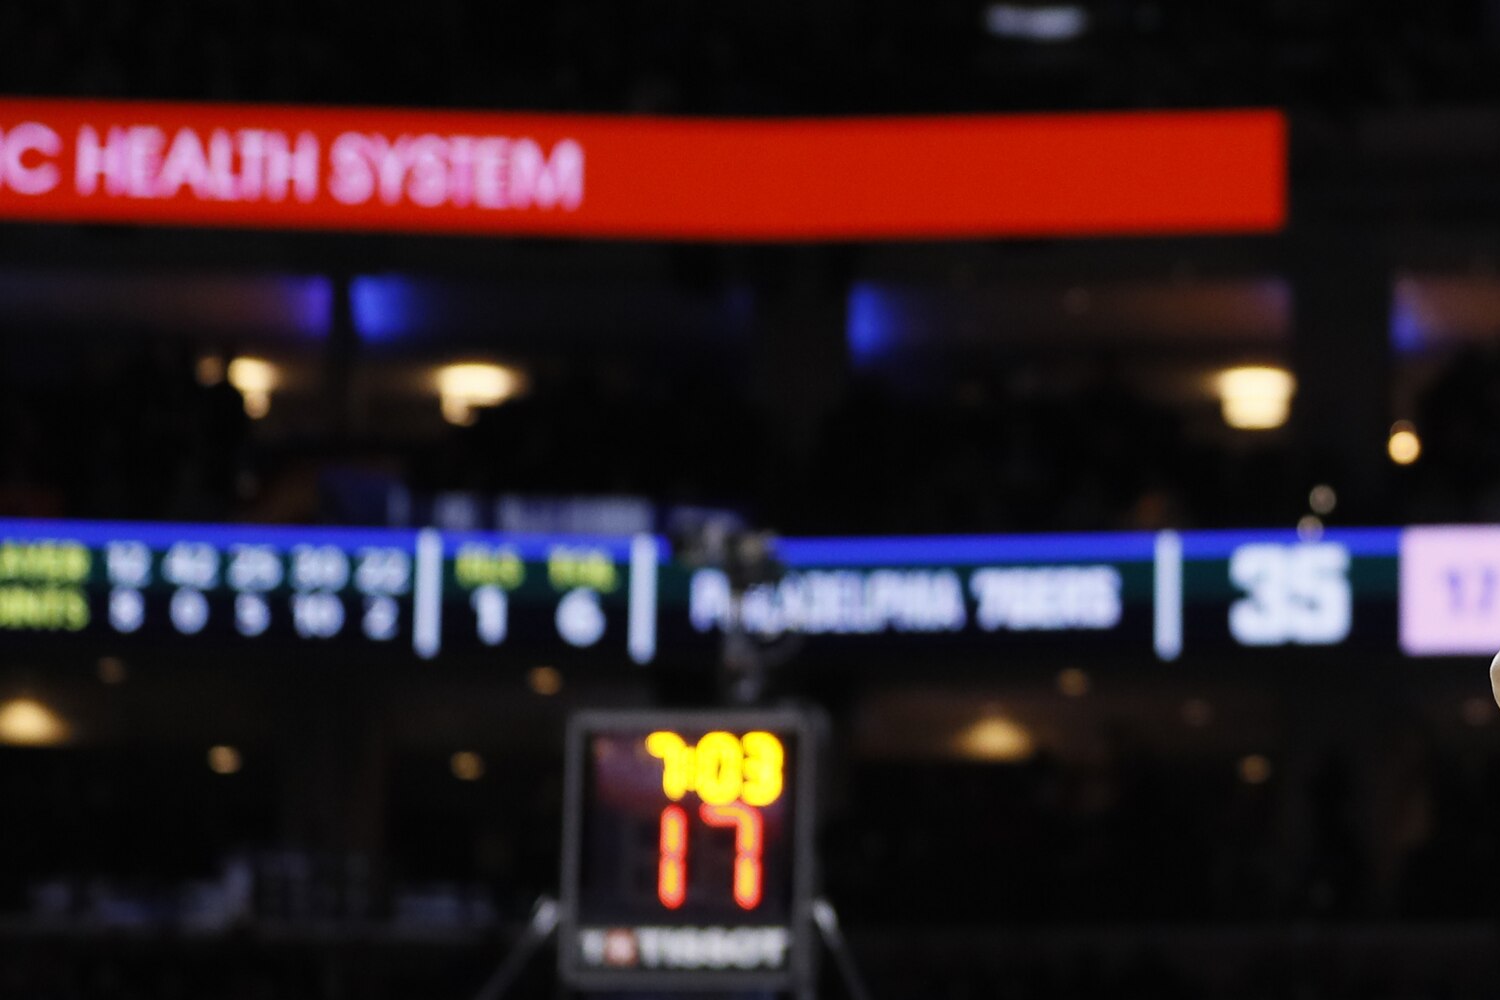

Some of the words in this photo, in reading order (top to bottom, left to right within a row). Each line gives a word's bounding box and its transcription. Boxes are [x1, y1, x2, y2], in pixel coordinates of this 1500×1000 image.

[0, 121, 62, 196] C
[74, 122, 320, 203] HEALTH
[328, 130, 586, 212] SYSTEM
[161, 541, 219, 590] 42
[1228, 542, 1351, 645] 35
[1442, 563, 1499, 611] 17
[472, 583, 508, 646] 1
[555, 586, 605, 648] 6
[645, 731, 783, 807] 7:03
[659, 804, 763, 910] 17
[636, 927, 787, 969] TISSOT
